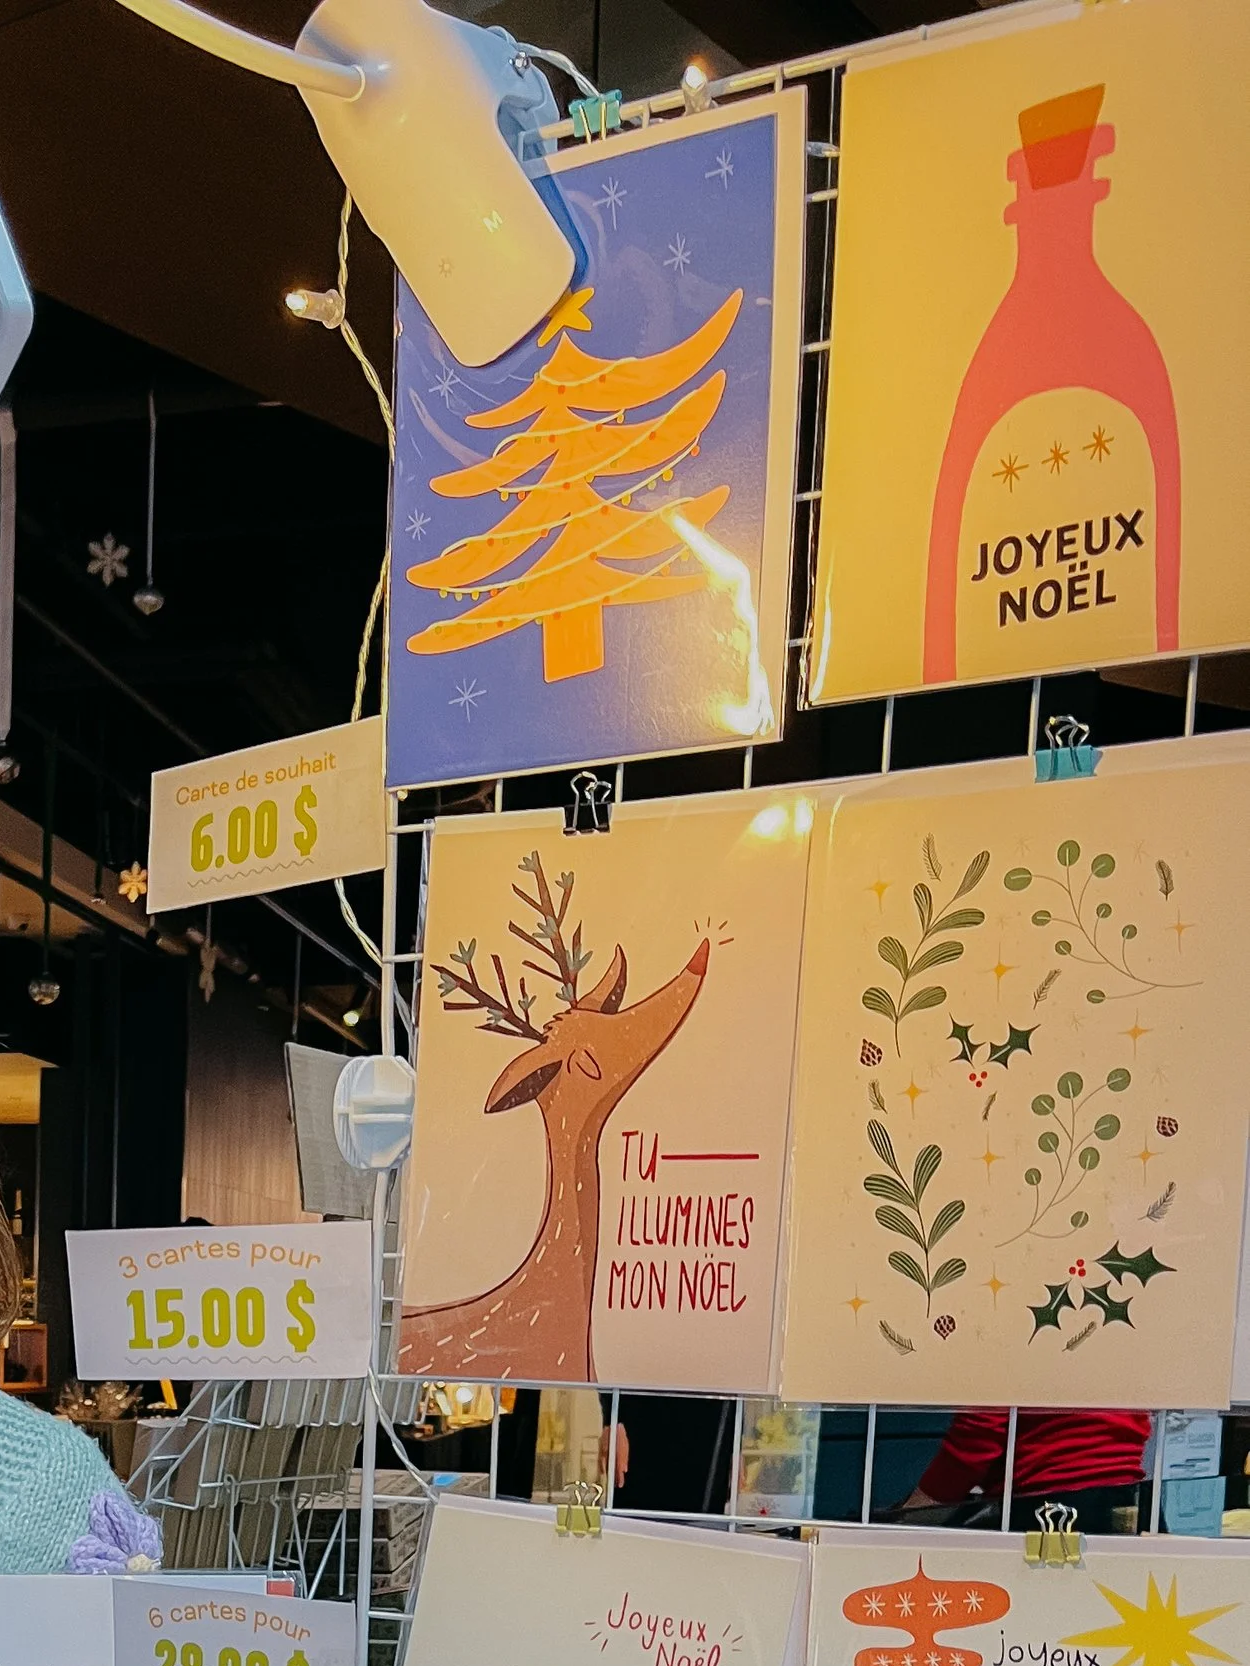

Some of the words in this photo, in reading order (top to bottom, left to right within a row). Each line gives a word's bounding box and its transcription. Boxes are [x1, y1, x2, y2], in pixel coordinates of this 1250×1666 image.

[971, 508, 1145, 582] JOYEUX
[999, 559, 1117, 628] NOËL
[176, 780, 230, 806] Carte
[235, 769, 259, 792] de
[264, 751, 337, 785] souhait
[190, 799, 278, 873] 6.00
[293, 784, 318, 857] $
[621, 1130, 659, 1183] TU
[617, 1193, 754, 1249] ILLUMINES
[118, 1255, 139, 1279] 3
[146, 1239, 241, 1270] cartes
[250, 1242, 322, 1269] pour
[608, 1260, 667, 1310] MON
[678, 1252, 747, 1313] NÖEL
[126, 1286, 265, 1350] 15.00
[286, 1279, 316, 1353] $
[149, 1606, 164, 1629] 6
[170, 1600, 247, 1623] cartes
[253, 1609, 311, 1642] pour
[607, 1591, 707, 1650] Joyeux
